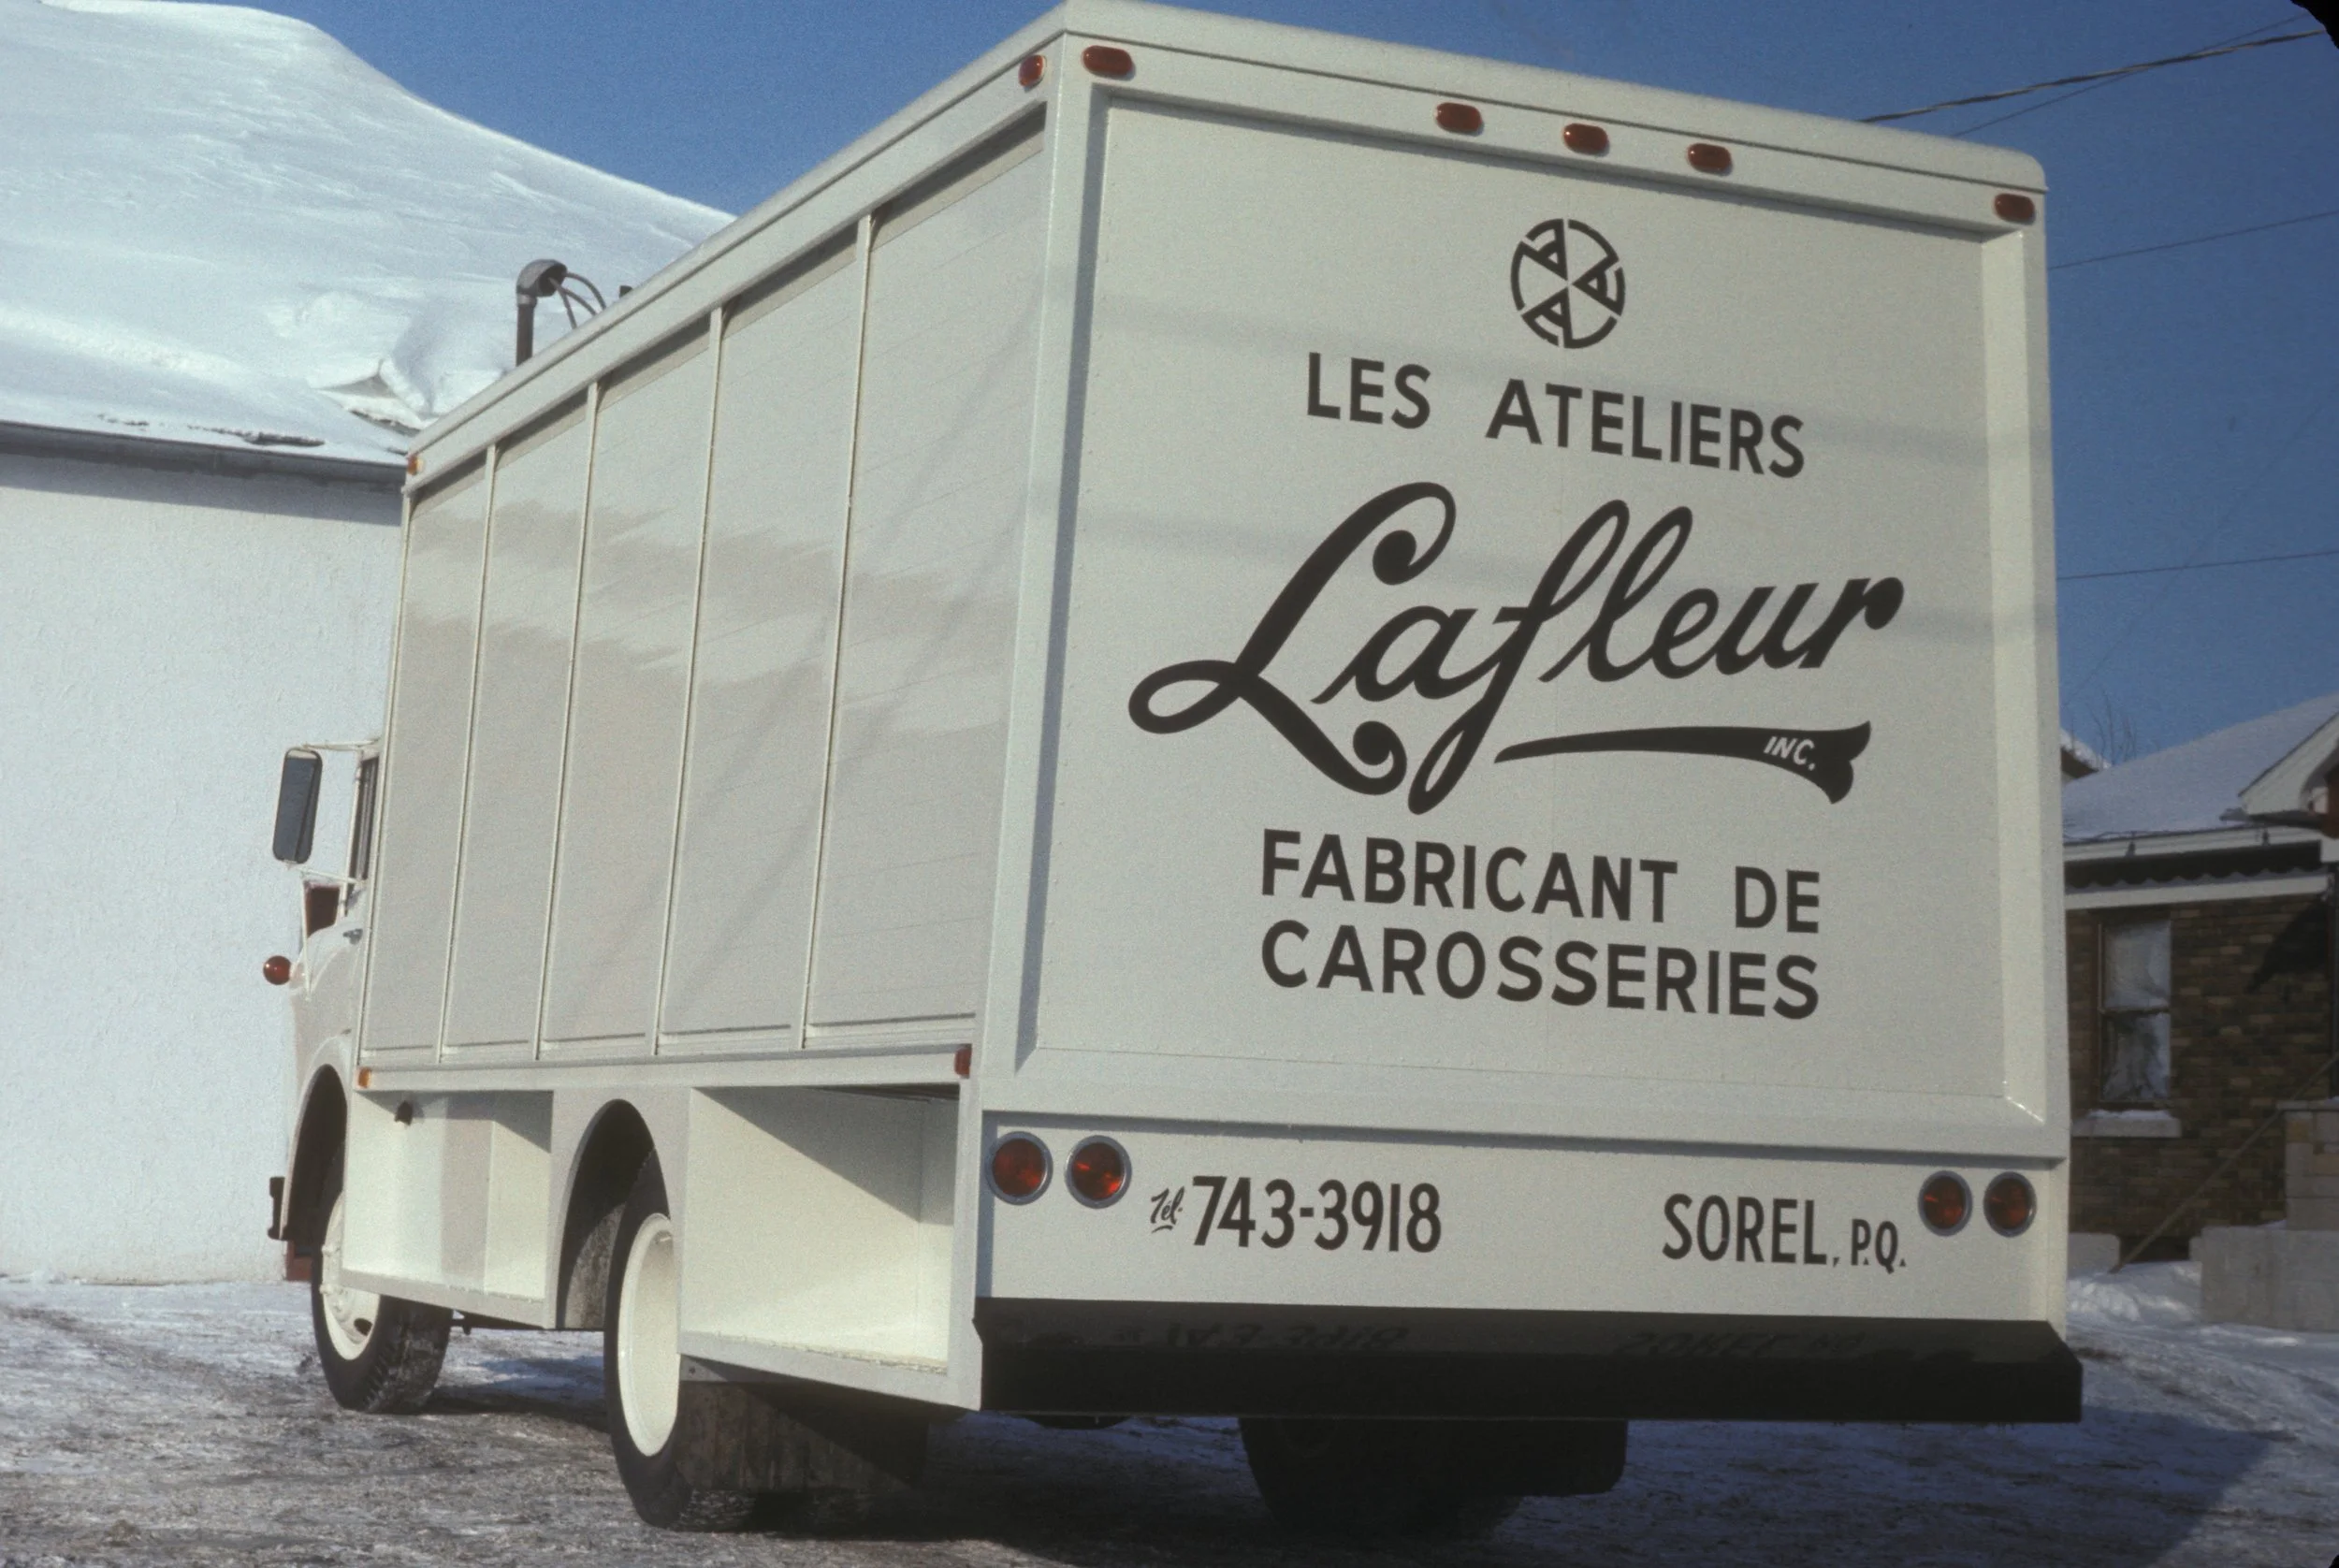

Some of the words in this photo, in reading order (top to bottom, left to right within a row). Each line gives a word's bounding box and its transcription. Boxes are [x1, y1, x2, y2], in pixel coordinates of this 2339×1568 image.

[1307, 352, 1431, 430] LES
[1485, 378, 1806, 479] ATELIERS
[1128, 481, 1905, 816] Lafleur
[1763, 735, 1816, 772] INC.
[1261, 828, 1679, 923] FABRICANT
[1734, 865, 1821, 935] DE
[1261, 920, 1820, 1021] CAROSSERIES
[1192, 1175, 1443, 1254] 743-3918
[1662, 1193, 1840, 1268] SOREL,
[1850, 1218, 1907, 1275] P.Q.
